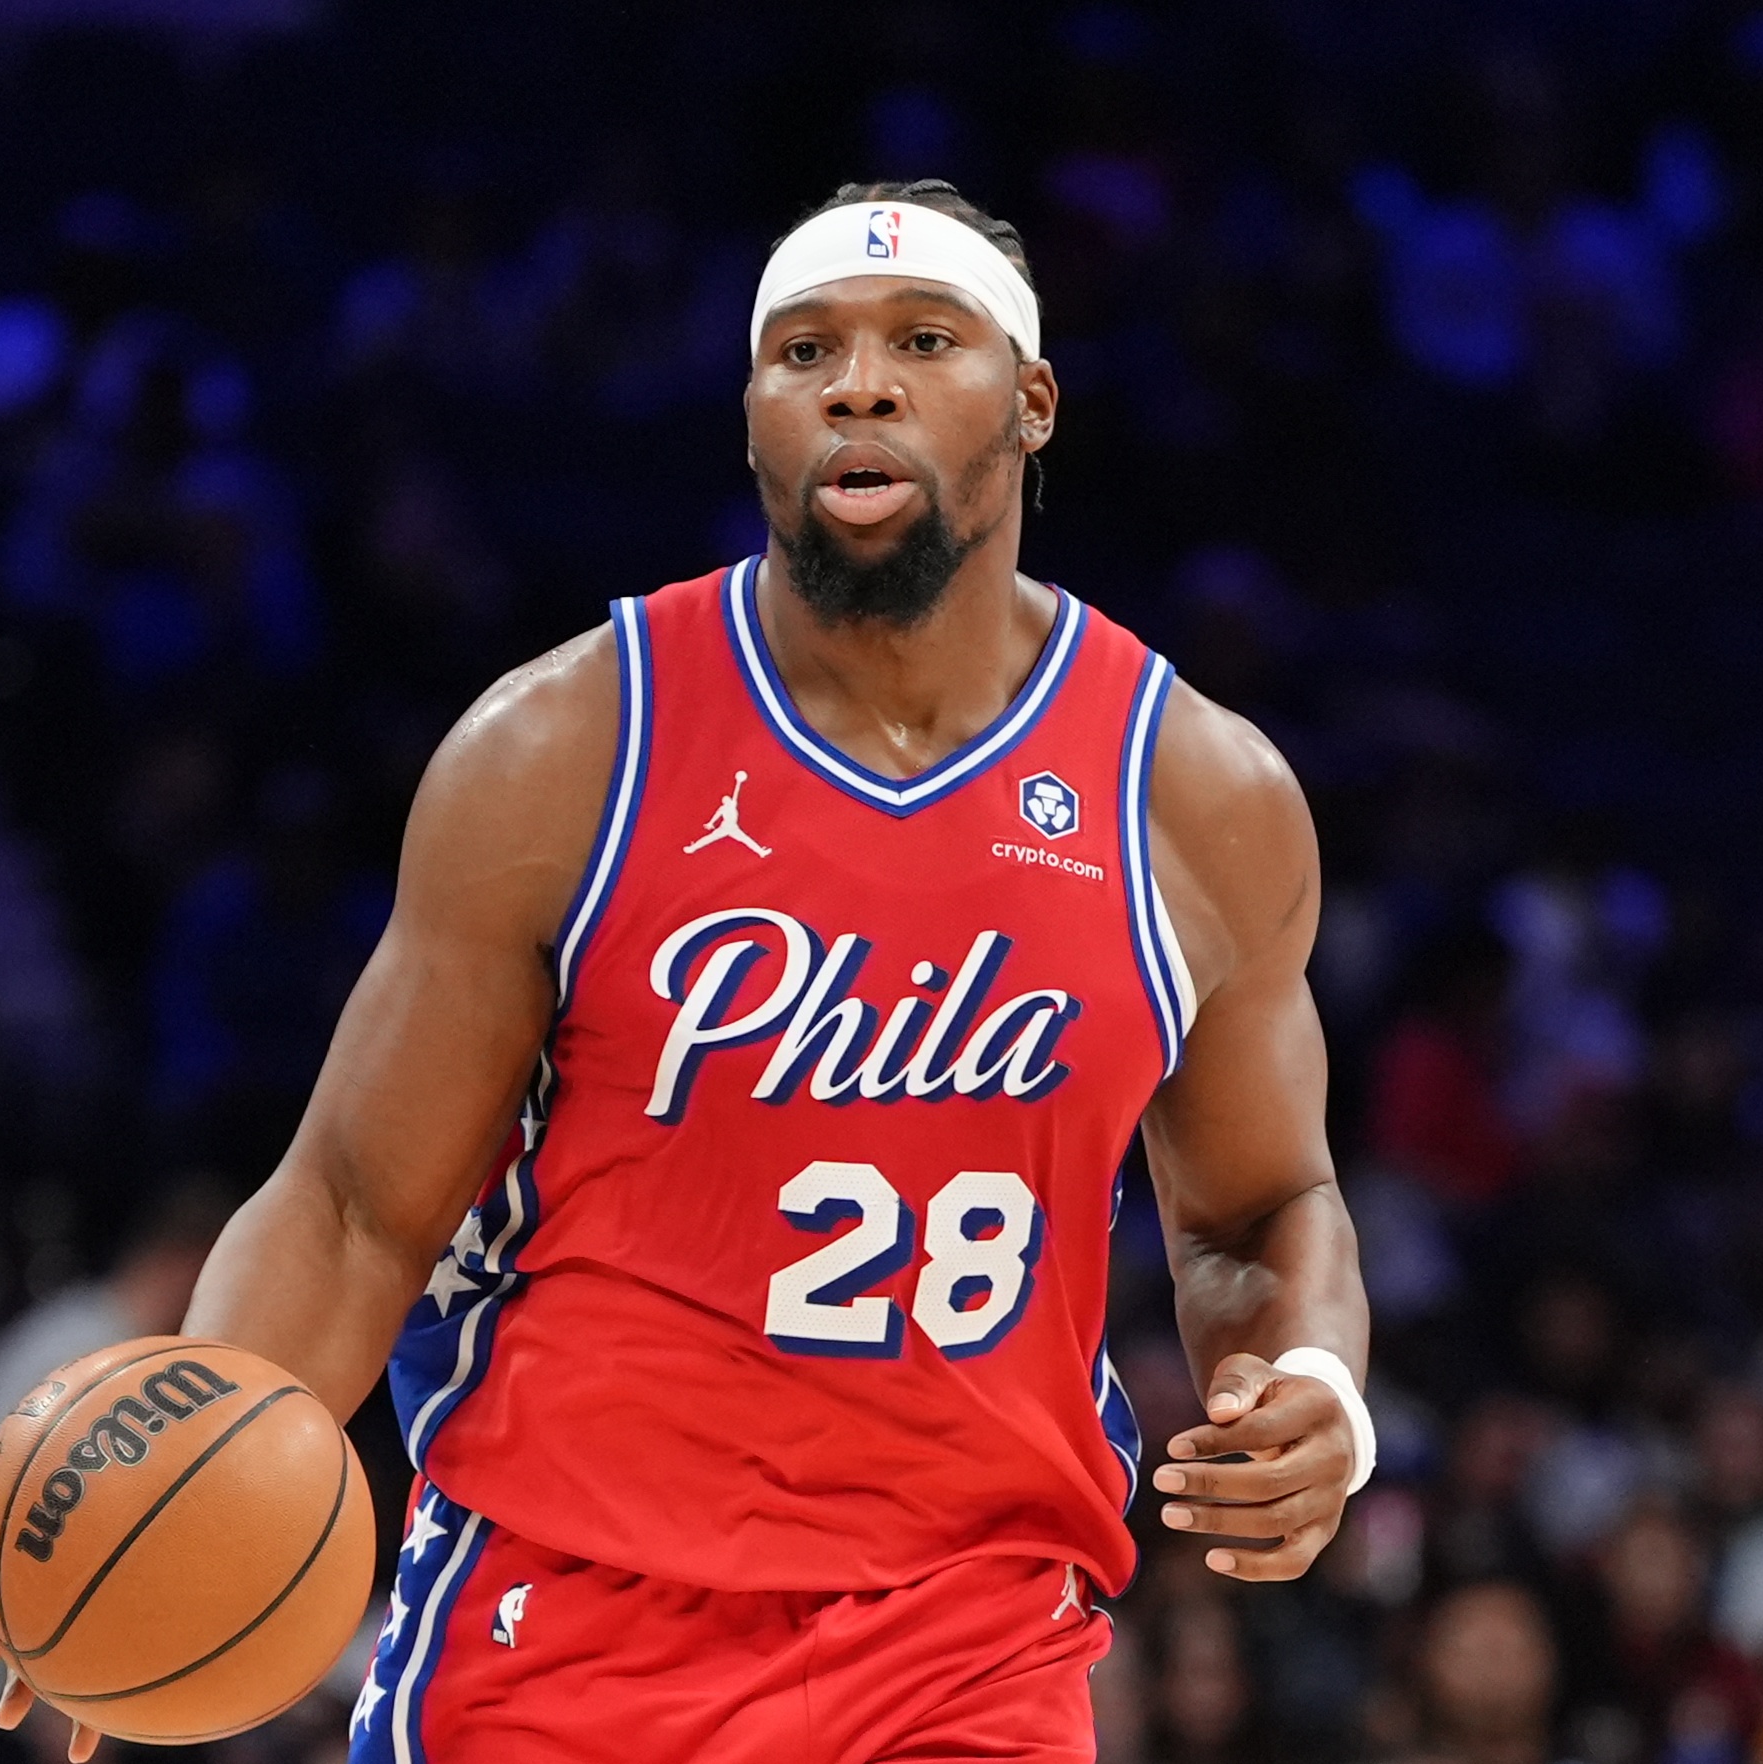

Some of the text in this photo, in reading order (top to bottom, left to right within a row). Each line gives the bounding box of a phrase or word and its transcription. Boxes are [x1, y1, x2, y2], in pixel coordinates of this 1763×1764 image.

[991, 840, 1104, 881] crypto.com
[643, 907, 1083, 1126] Phila
[763, 1160, 1046, 1360] 28
[14, 1360, 241, 1562] Wilson
